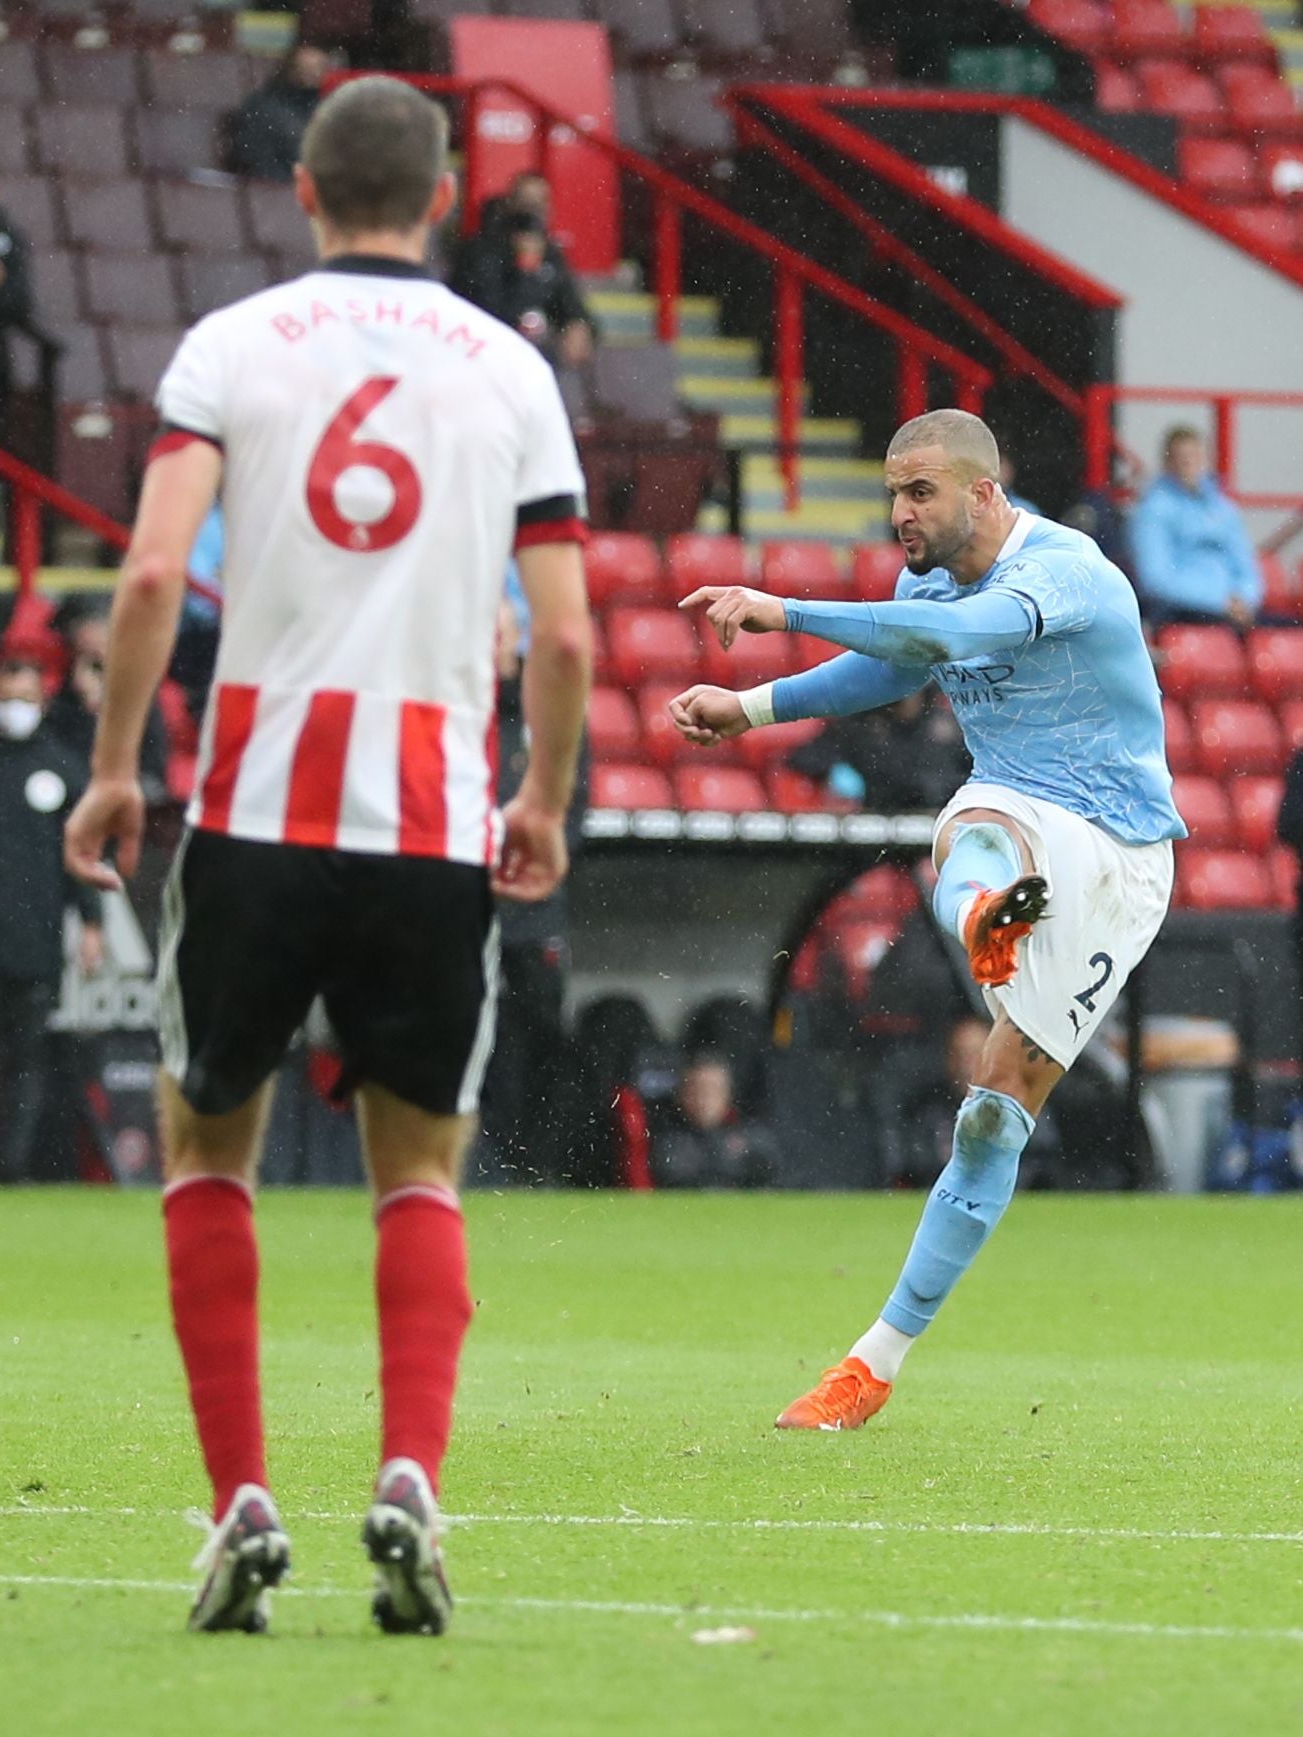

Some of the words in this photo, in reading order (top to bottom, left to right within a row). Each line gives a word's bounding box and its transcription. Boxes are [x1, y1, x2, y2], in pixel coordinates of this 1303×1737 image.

[270, 299, 486, 360] BASHAM
[306, 374, 423, 553] 6
[1073, 951, 1113, 1014] 2
[937, 1188, 981, 1212] CITY
